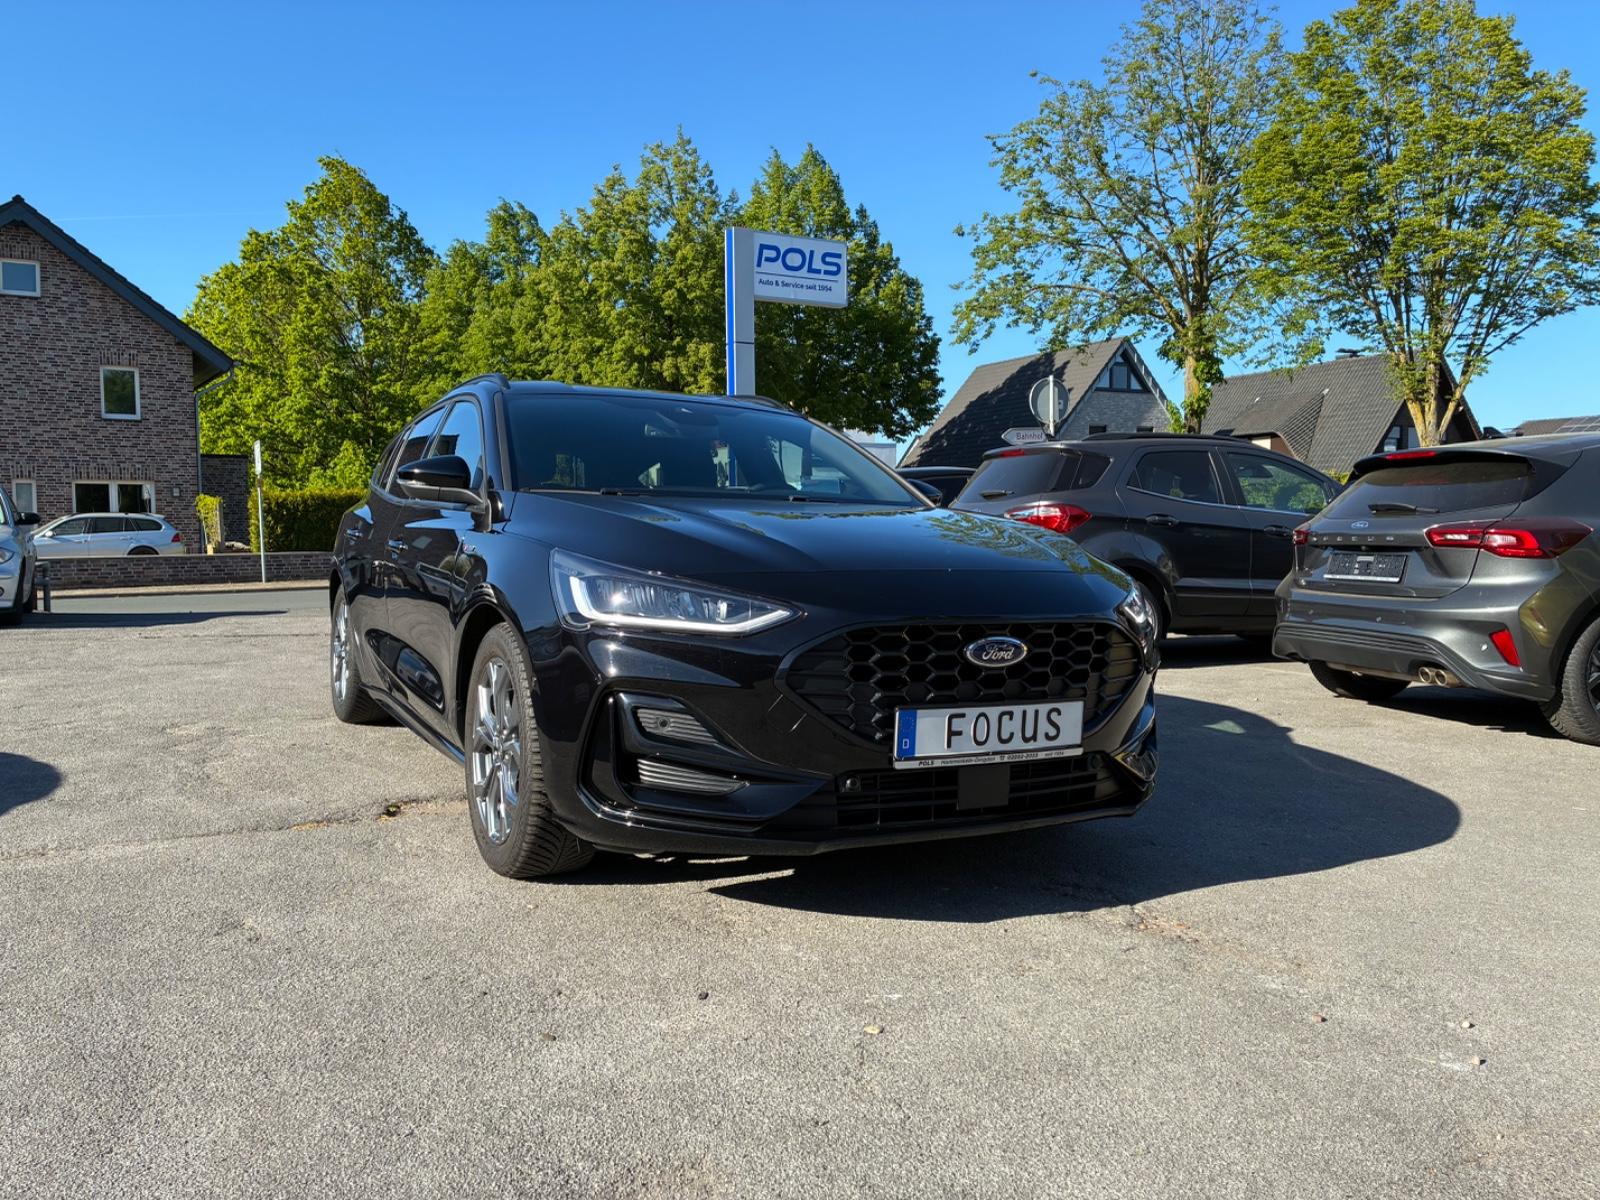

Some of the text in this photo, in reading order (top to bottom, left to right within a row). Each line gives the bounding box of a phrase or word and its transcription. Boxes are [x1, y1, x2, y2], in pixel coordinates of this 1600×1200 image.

[756, 243, 842, 276] POLS
[759, 278, 774, 286] Auto
[781, 280, 804, 289] Service
[1016, 432, 1043, 440] Bahnhof
[982, 643, 1015, 660] Ford
[946, 707, 1062, 749] FOCUS
[902, 738, 910, 749] D
